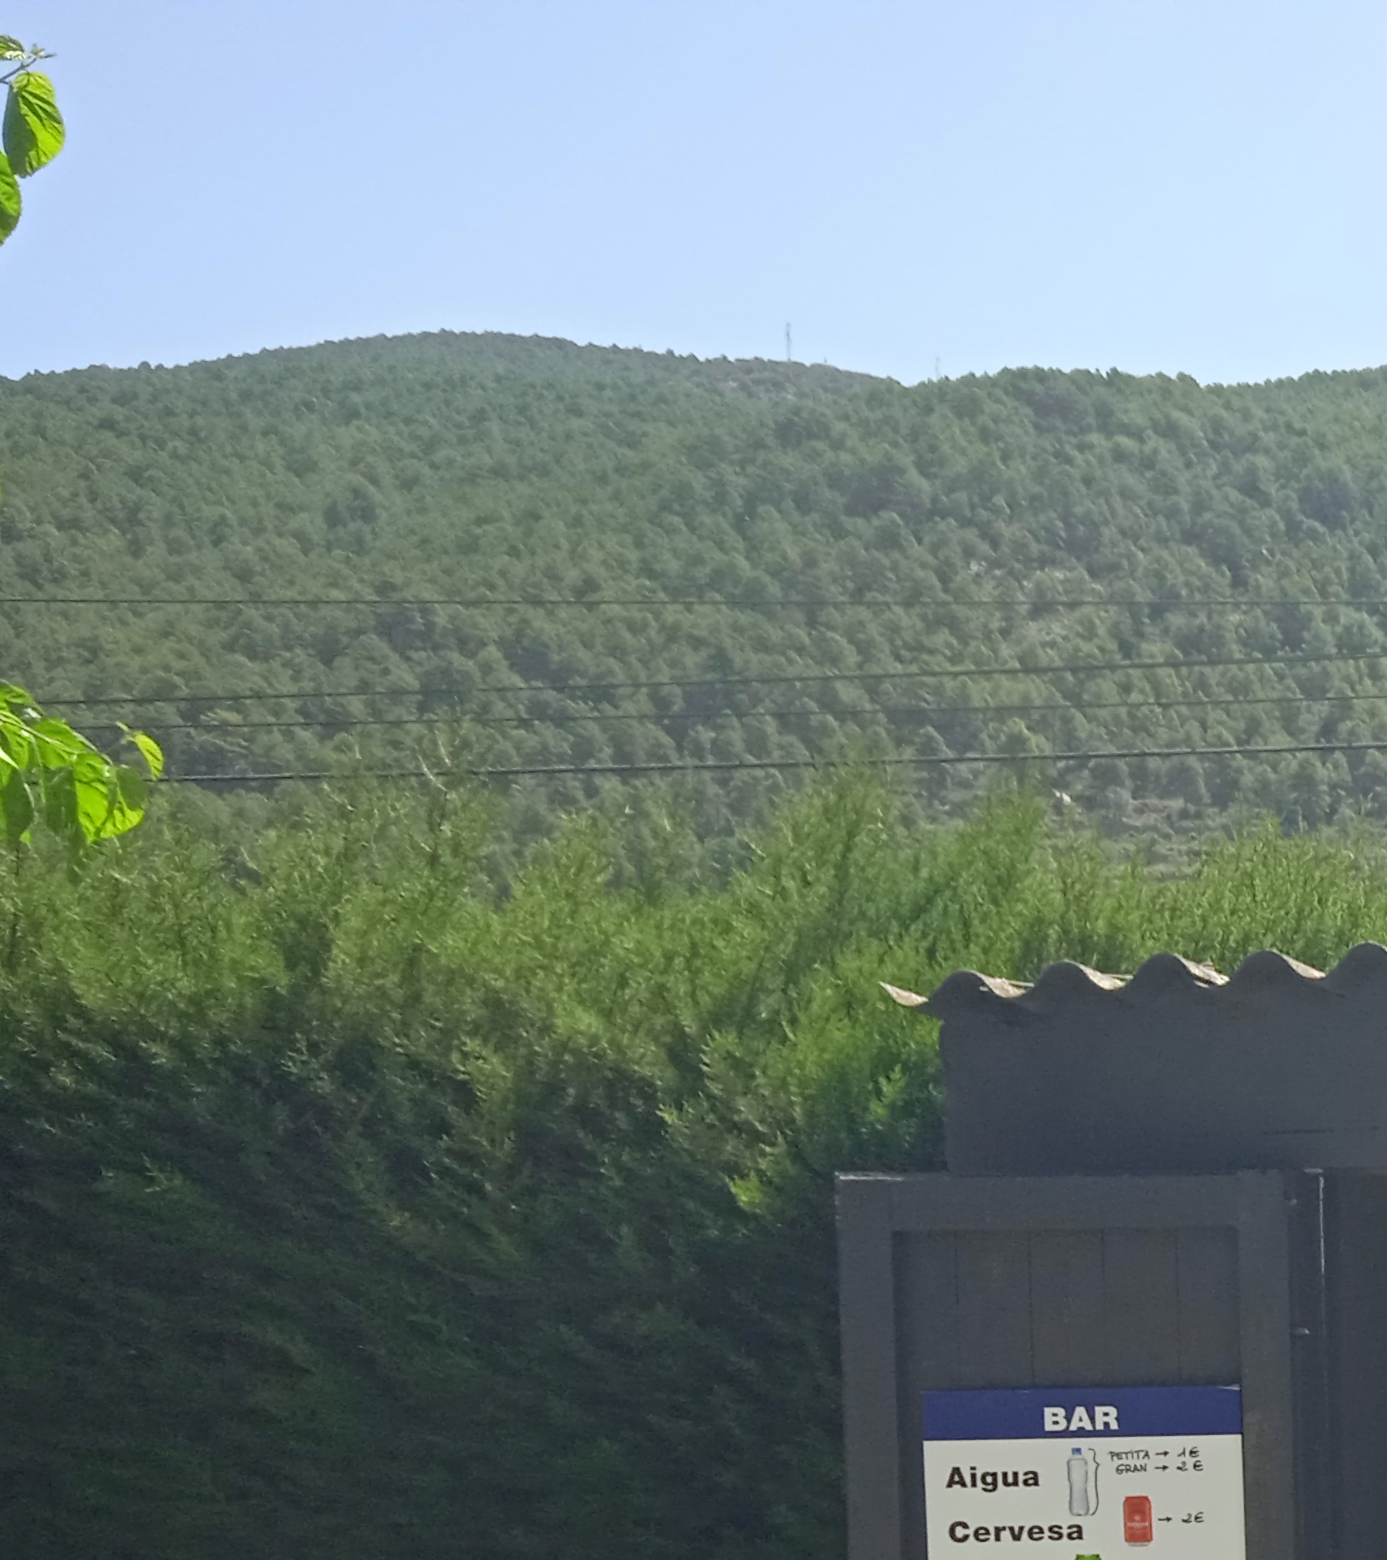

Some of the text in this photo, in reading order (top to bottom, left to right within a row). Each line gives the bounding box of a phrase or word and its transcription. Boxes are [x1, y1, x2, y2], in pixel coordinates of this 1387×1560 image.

[1043, 1405, 1120, 1432] BAR
[1107, 1449, 1151, 1462] PETITA
[945, 1465, 1041, 1493] Aigua
[1115, 1463, 1148, 1475] GRAN
[947, 1520, 1085, 1544] Cervesa
